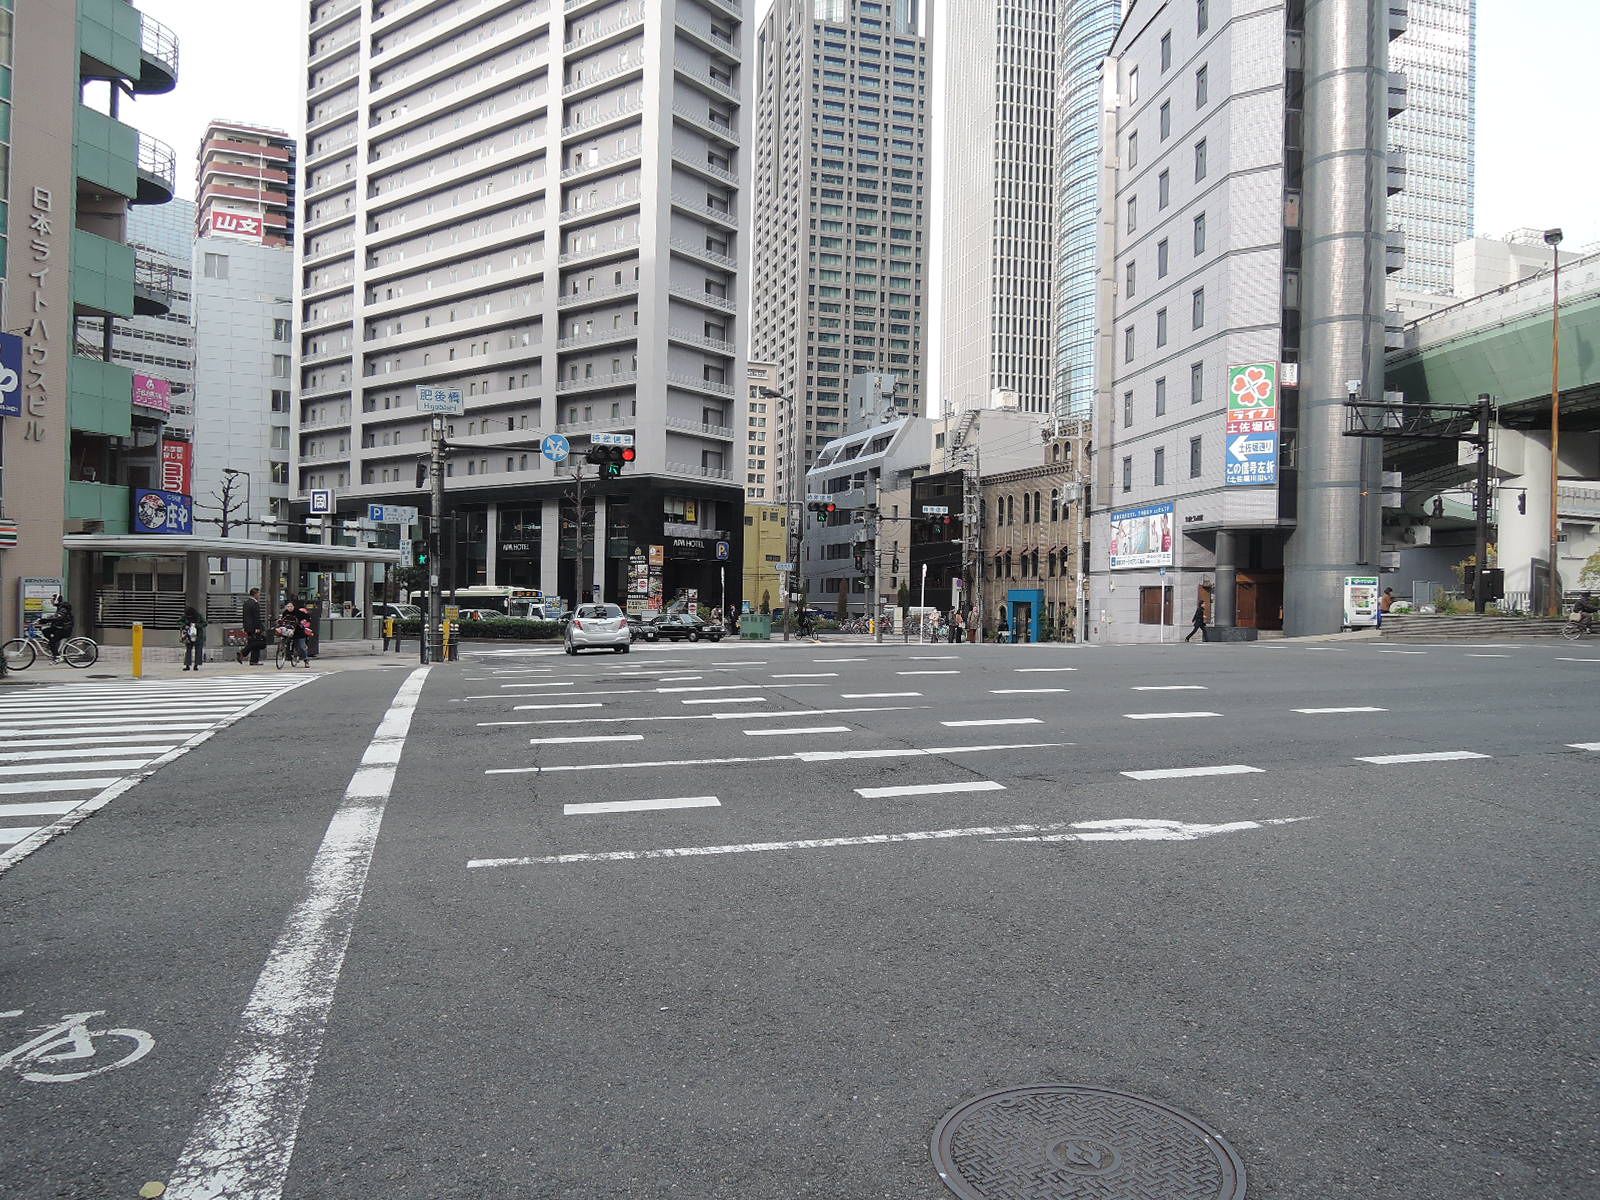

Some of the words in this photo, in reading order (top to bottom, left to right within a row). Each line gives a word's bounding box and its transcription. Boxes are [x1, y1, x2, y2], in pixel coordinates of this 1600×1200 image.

[216, 215, 259, 234] 山文
[28, 186, 50, 442] 日本ライトハウスビル
[420, 389, 460, 403] 肥後橋
[1231, 408, 1271, 420] ライフ
[1227, 420, 1275, 433] 土佐堀店
[1227, 460, 1275, 474] この信号左折
[167, 503, 188, 529] 庄や
[686, 540, 704, 548] HOTEL
